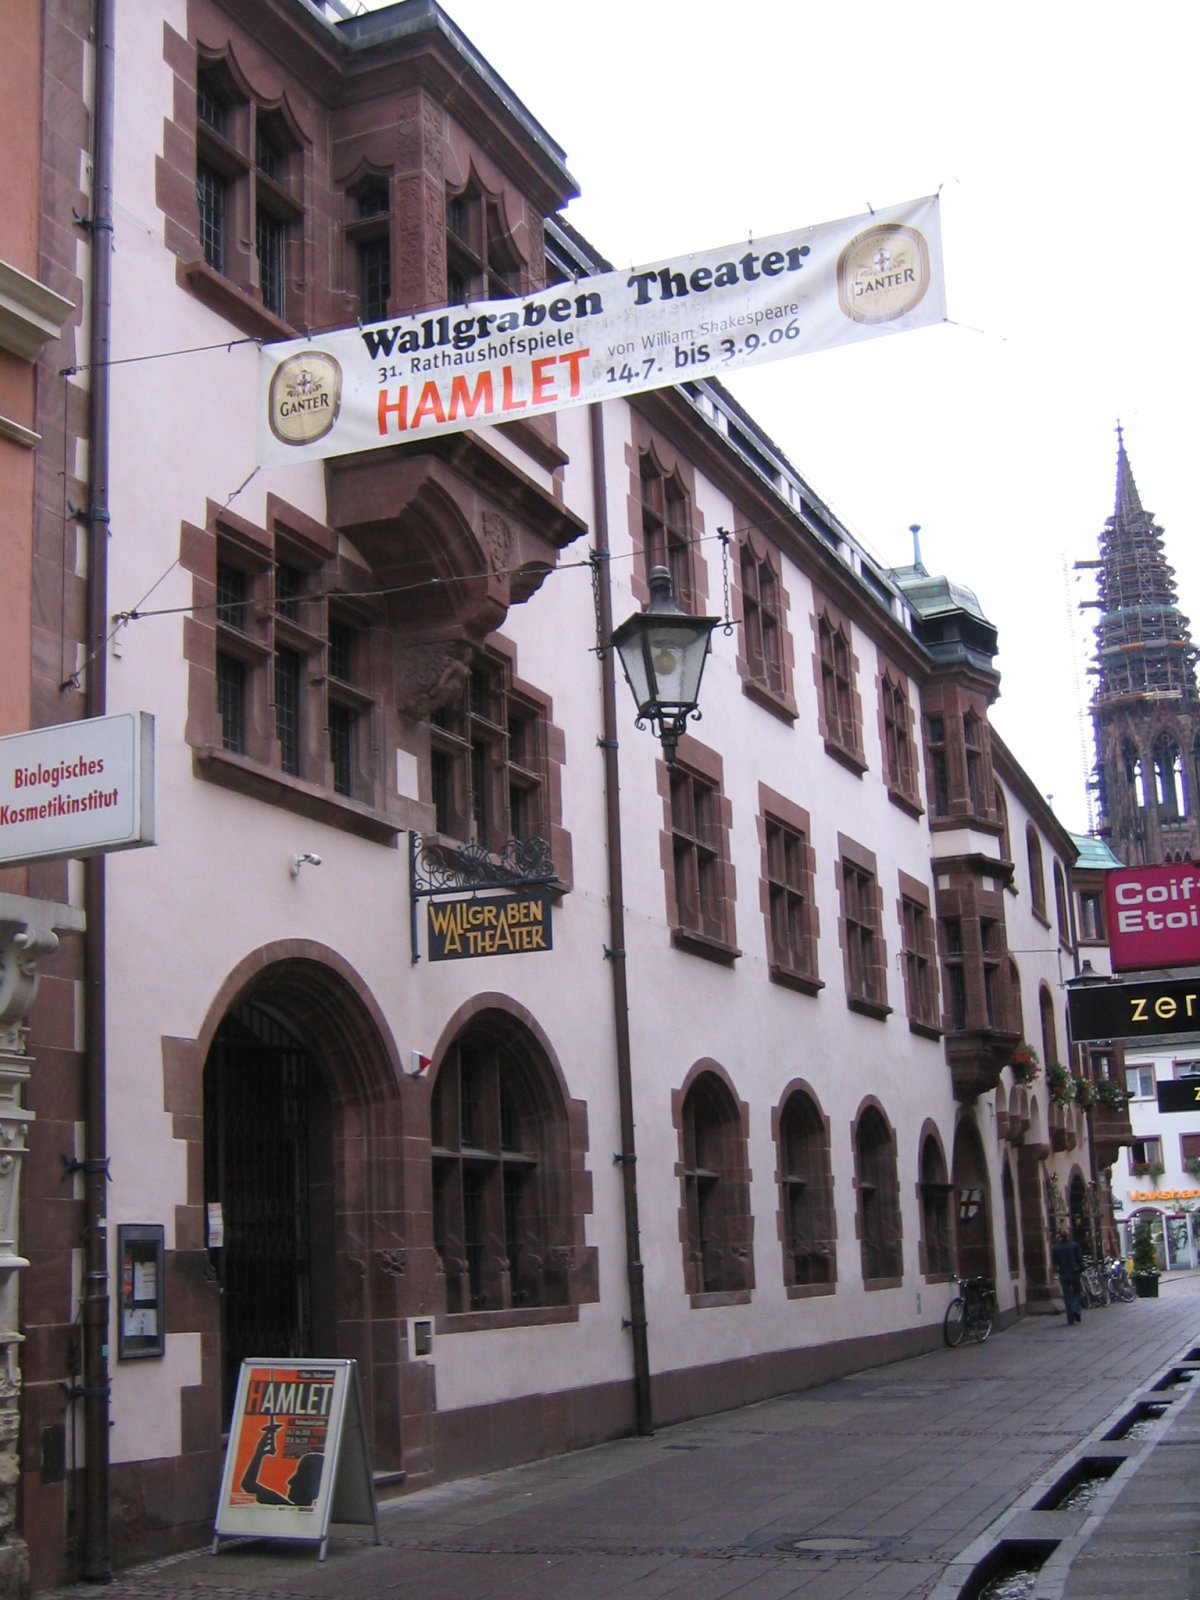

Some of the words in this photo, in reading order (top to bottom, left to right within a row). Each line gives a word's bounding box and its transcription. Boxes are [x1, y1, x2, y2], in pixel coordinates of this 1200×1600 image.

[361, 291, 604, 360] Wallgraben
[627, 245, 811, 306] Theater
[608, 341, 635, 357] von
[641, 328, 694, 350] William
[700, 303, 799, 336] Shakespeare
[378, 367, 403, 383] 31.
[411, 329, 574, 373] Rathaushofspiele
[606, 358, 663, 384] 14.7.
[674, 341, 710, 368] bis
[720, 318, 801, 362] 3.9.06
[280, 393, 330, 417] GANTER
[377, 347, 590, 436] HAMLET
[15, 755, 104, 789] Biologisches
[0, 788, 119, 825] Kosmetikinstitut
[1118, 904, 1199, 933] Etoi
[1130, 994, 1197, 1022] zer
[246, 1382, 333, 1415] HAMLET
